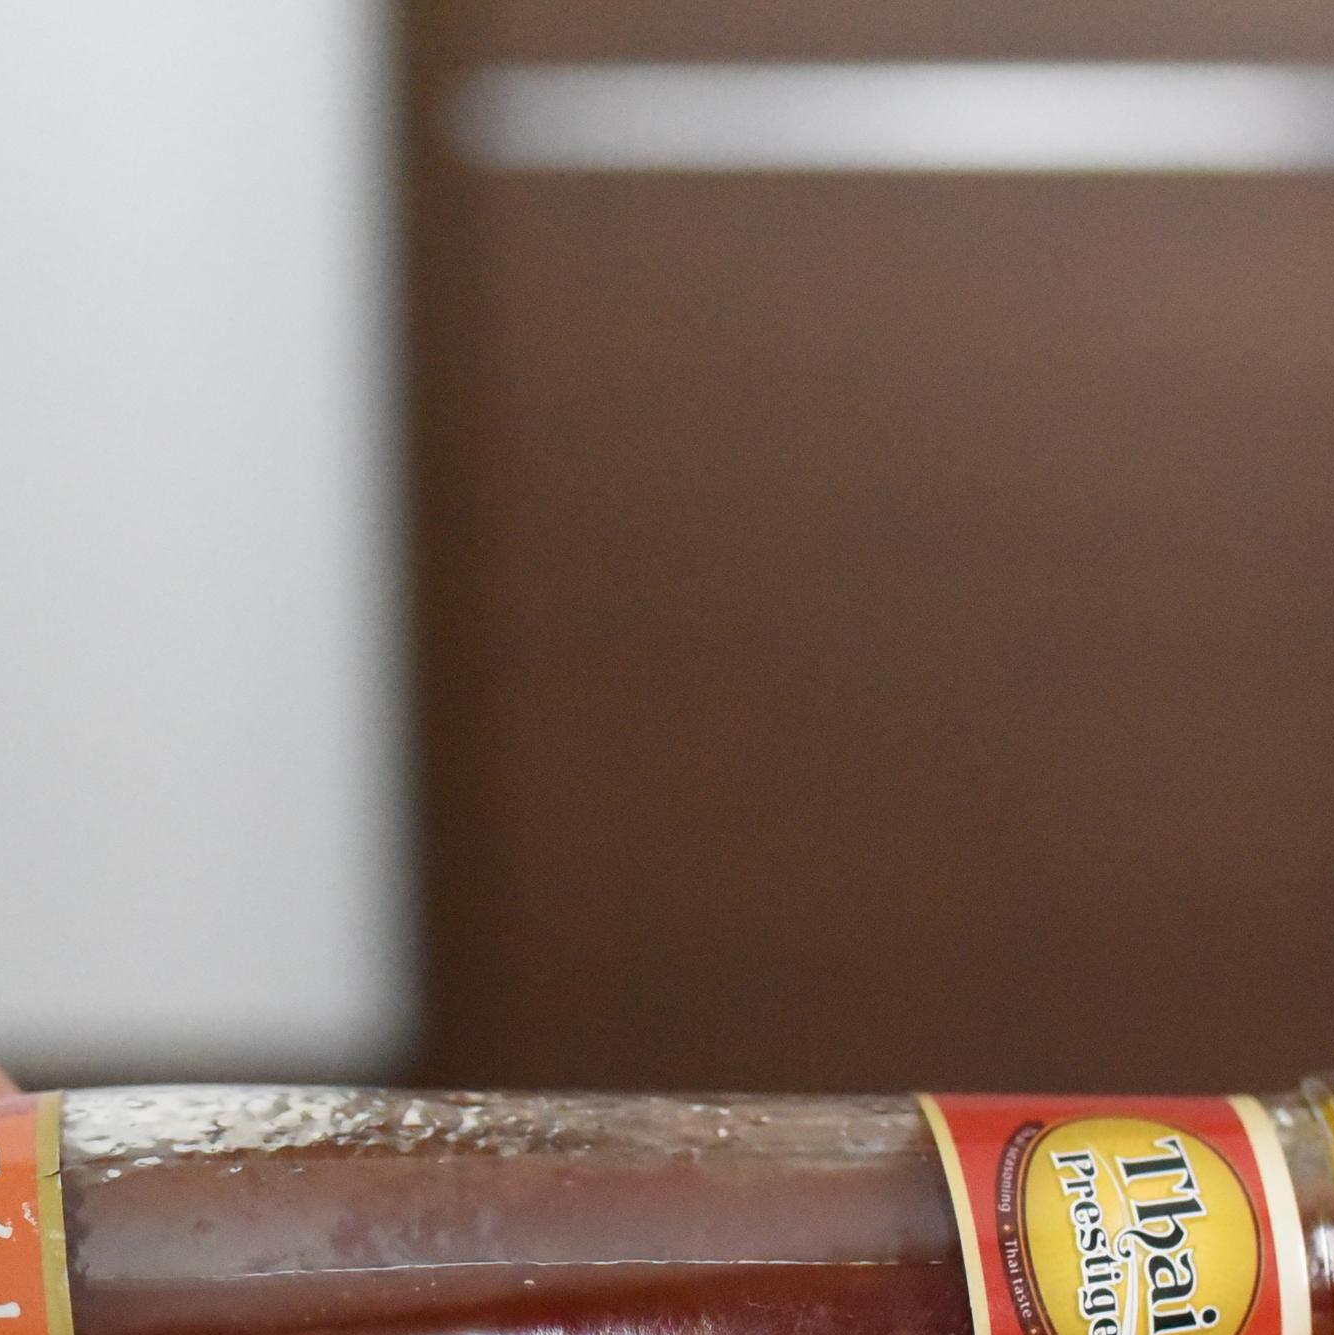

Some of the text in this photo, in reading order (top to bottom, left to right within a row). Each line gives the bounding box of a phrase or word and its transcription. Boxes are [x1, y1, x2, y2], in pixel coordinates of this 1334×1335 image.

[998, 1143, 1021, 1213] seasoning
[1004, 1239, 1034, 1320] Thai taste
